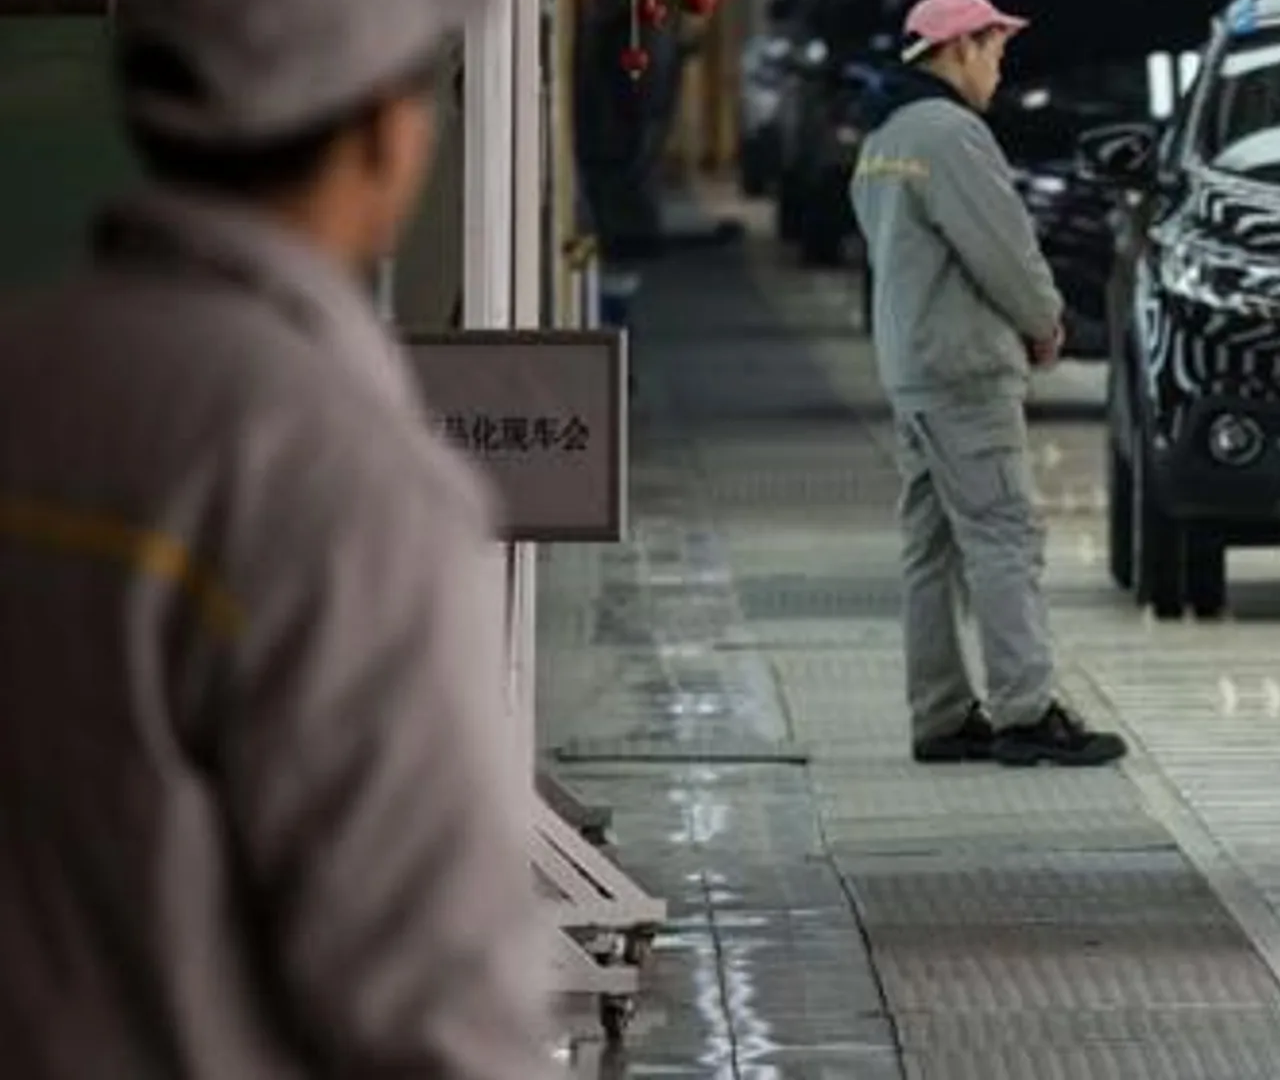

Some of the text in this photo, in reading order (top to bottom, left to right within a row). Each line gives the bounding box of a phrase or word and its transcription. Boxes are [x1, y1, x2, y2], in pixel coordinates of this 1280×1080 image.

[433, 415, 590, 452] 品化现车会
